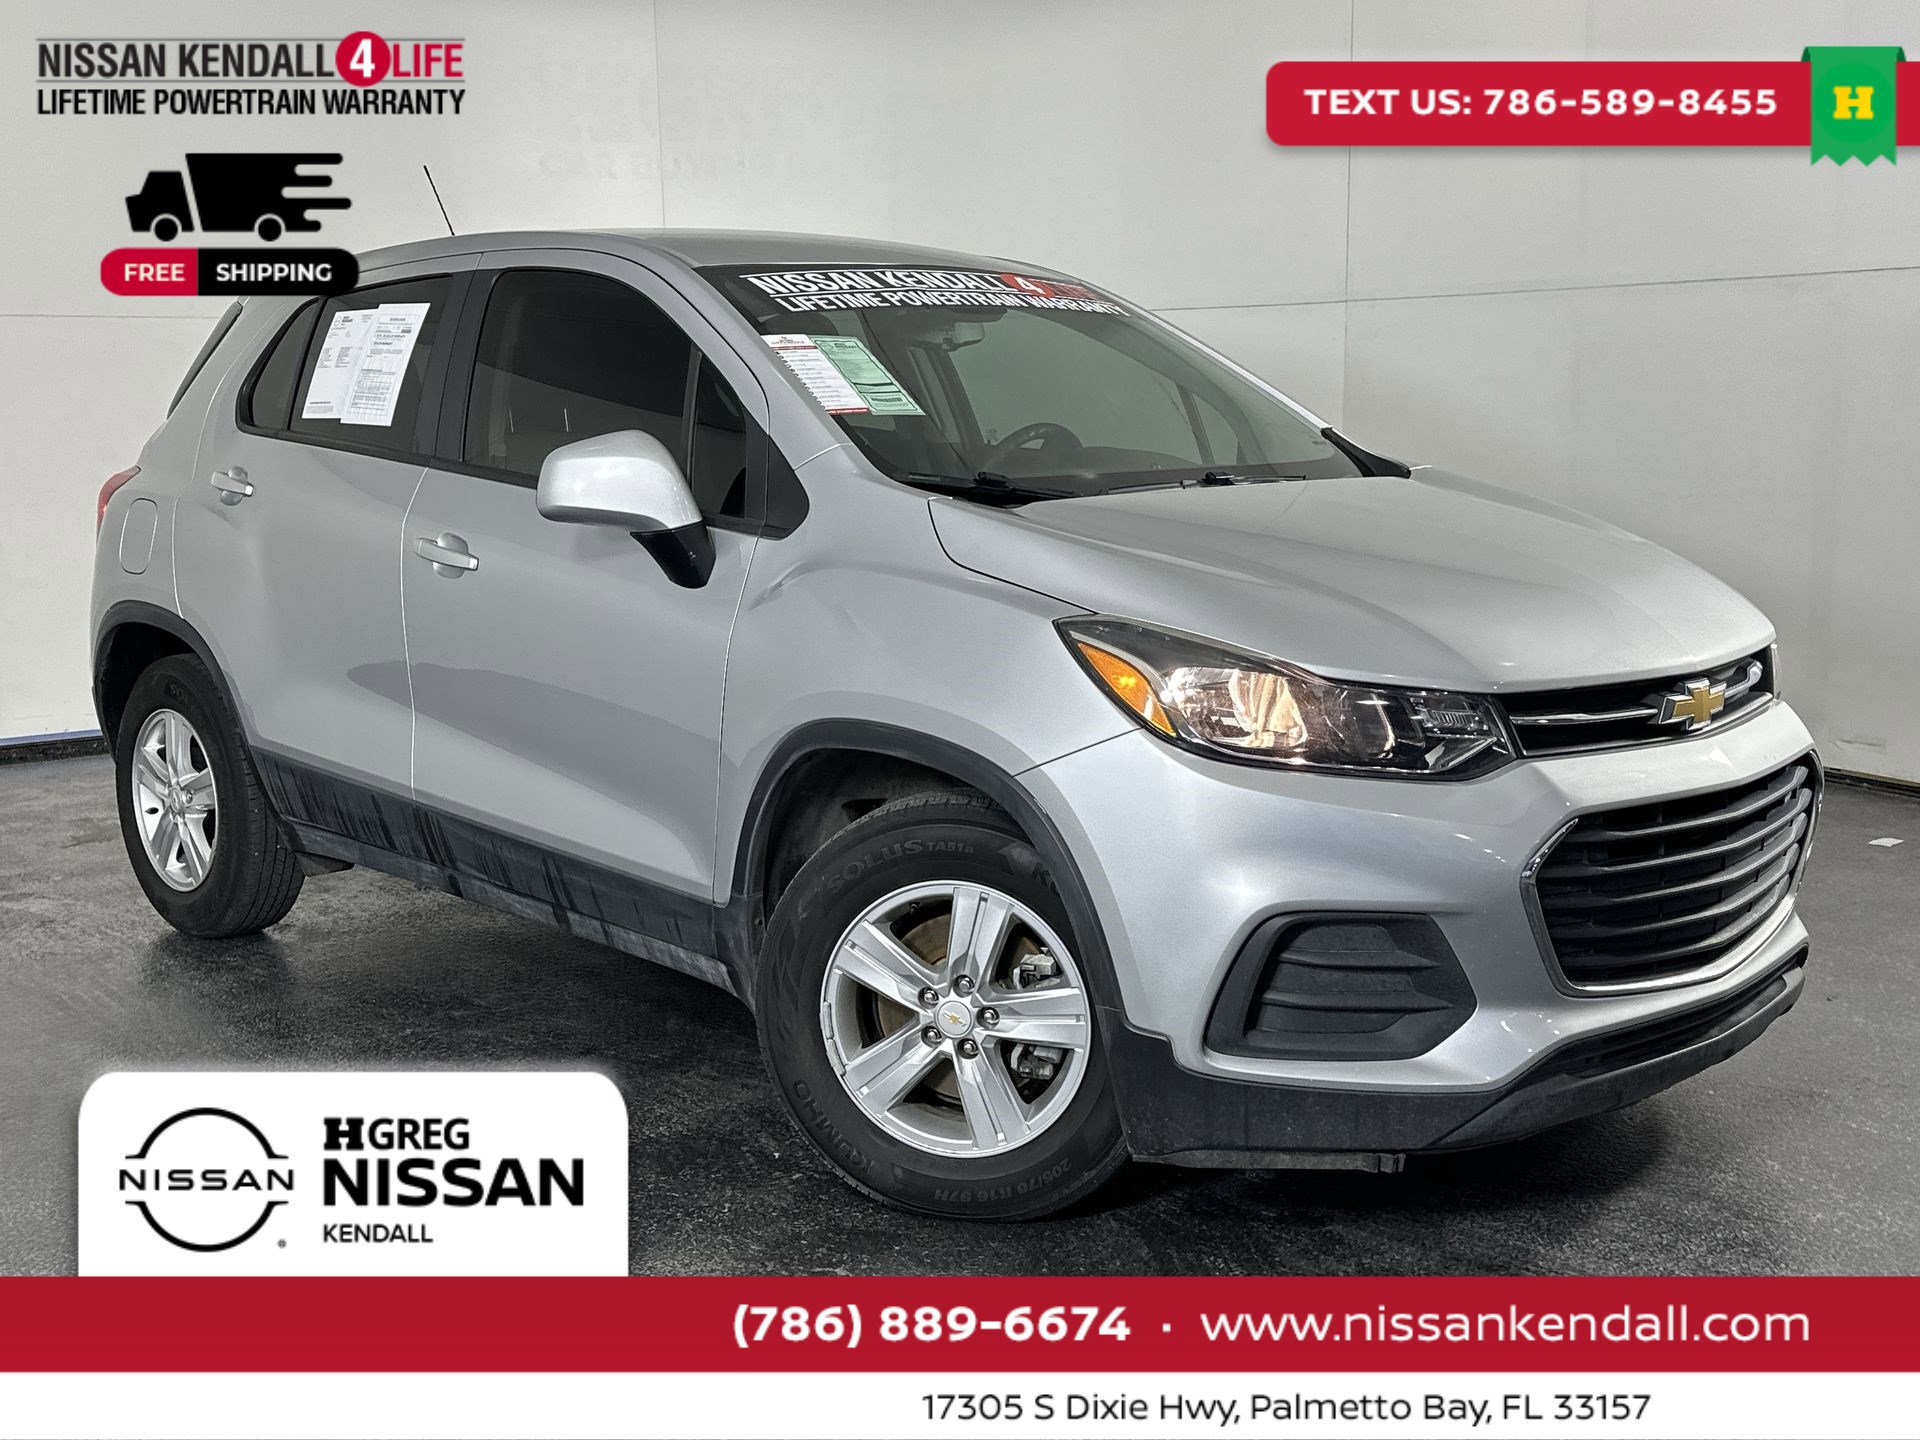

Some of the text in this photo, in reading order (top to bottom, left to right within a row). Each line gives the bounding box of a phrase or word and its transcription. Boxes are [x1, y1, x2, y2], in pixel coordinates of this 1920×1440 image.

[748, 271, 884, 295] NISSAN
[874, 271, 1019, 292] KENDALL
[1014, 276, 1047, 295] 4
[775, 292, 891, 312] LIFETIME
[884, 291, 1029, 307] POWERTRAIN
[824, 838, 923, 893] SOLUS
